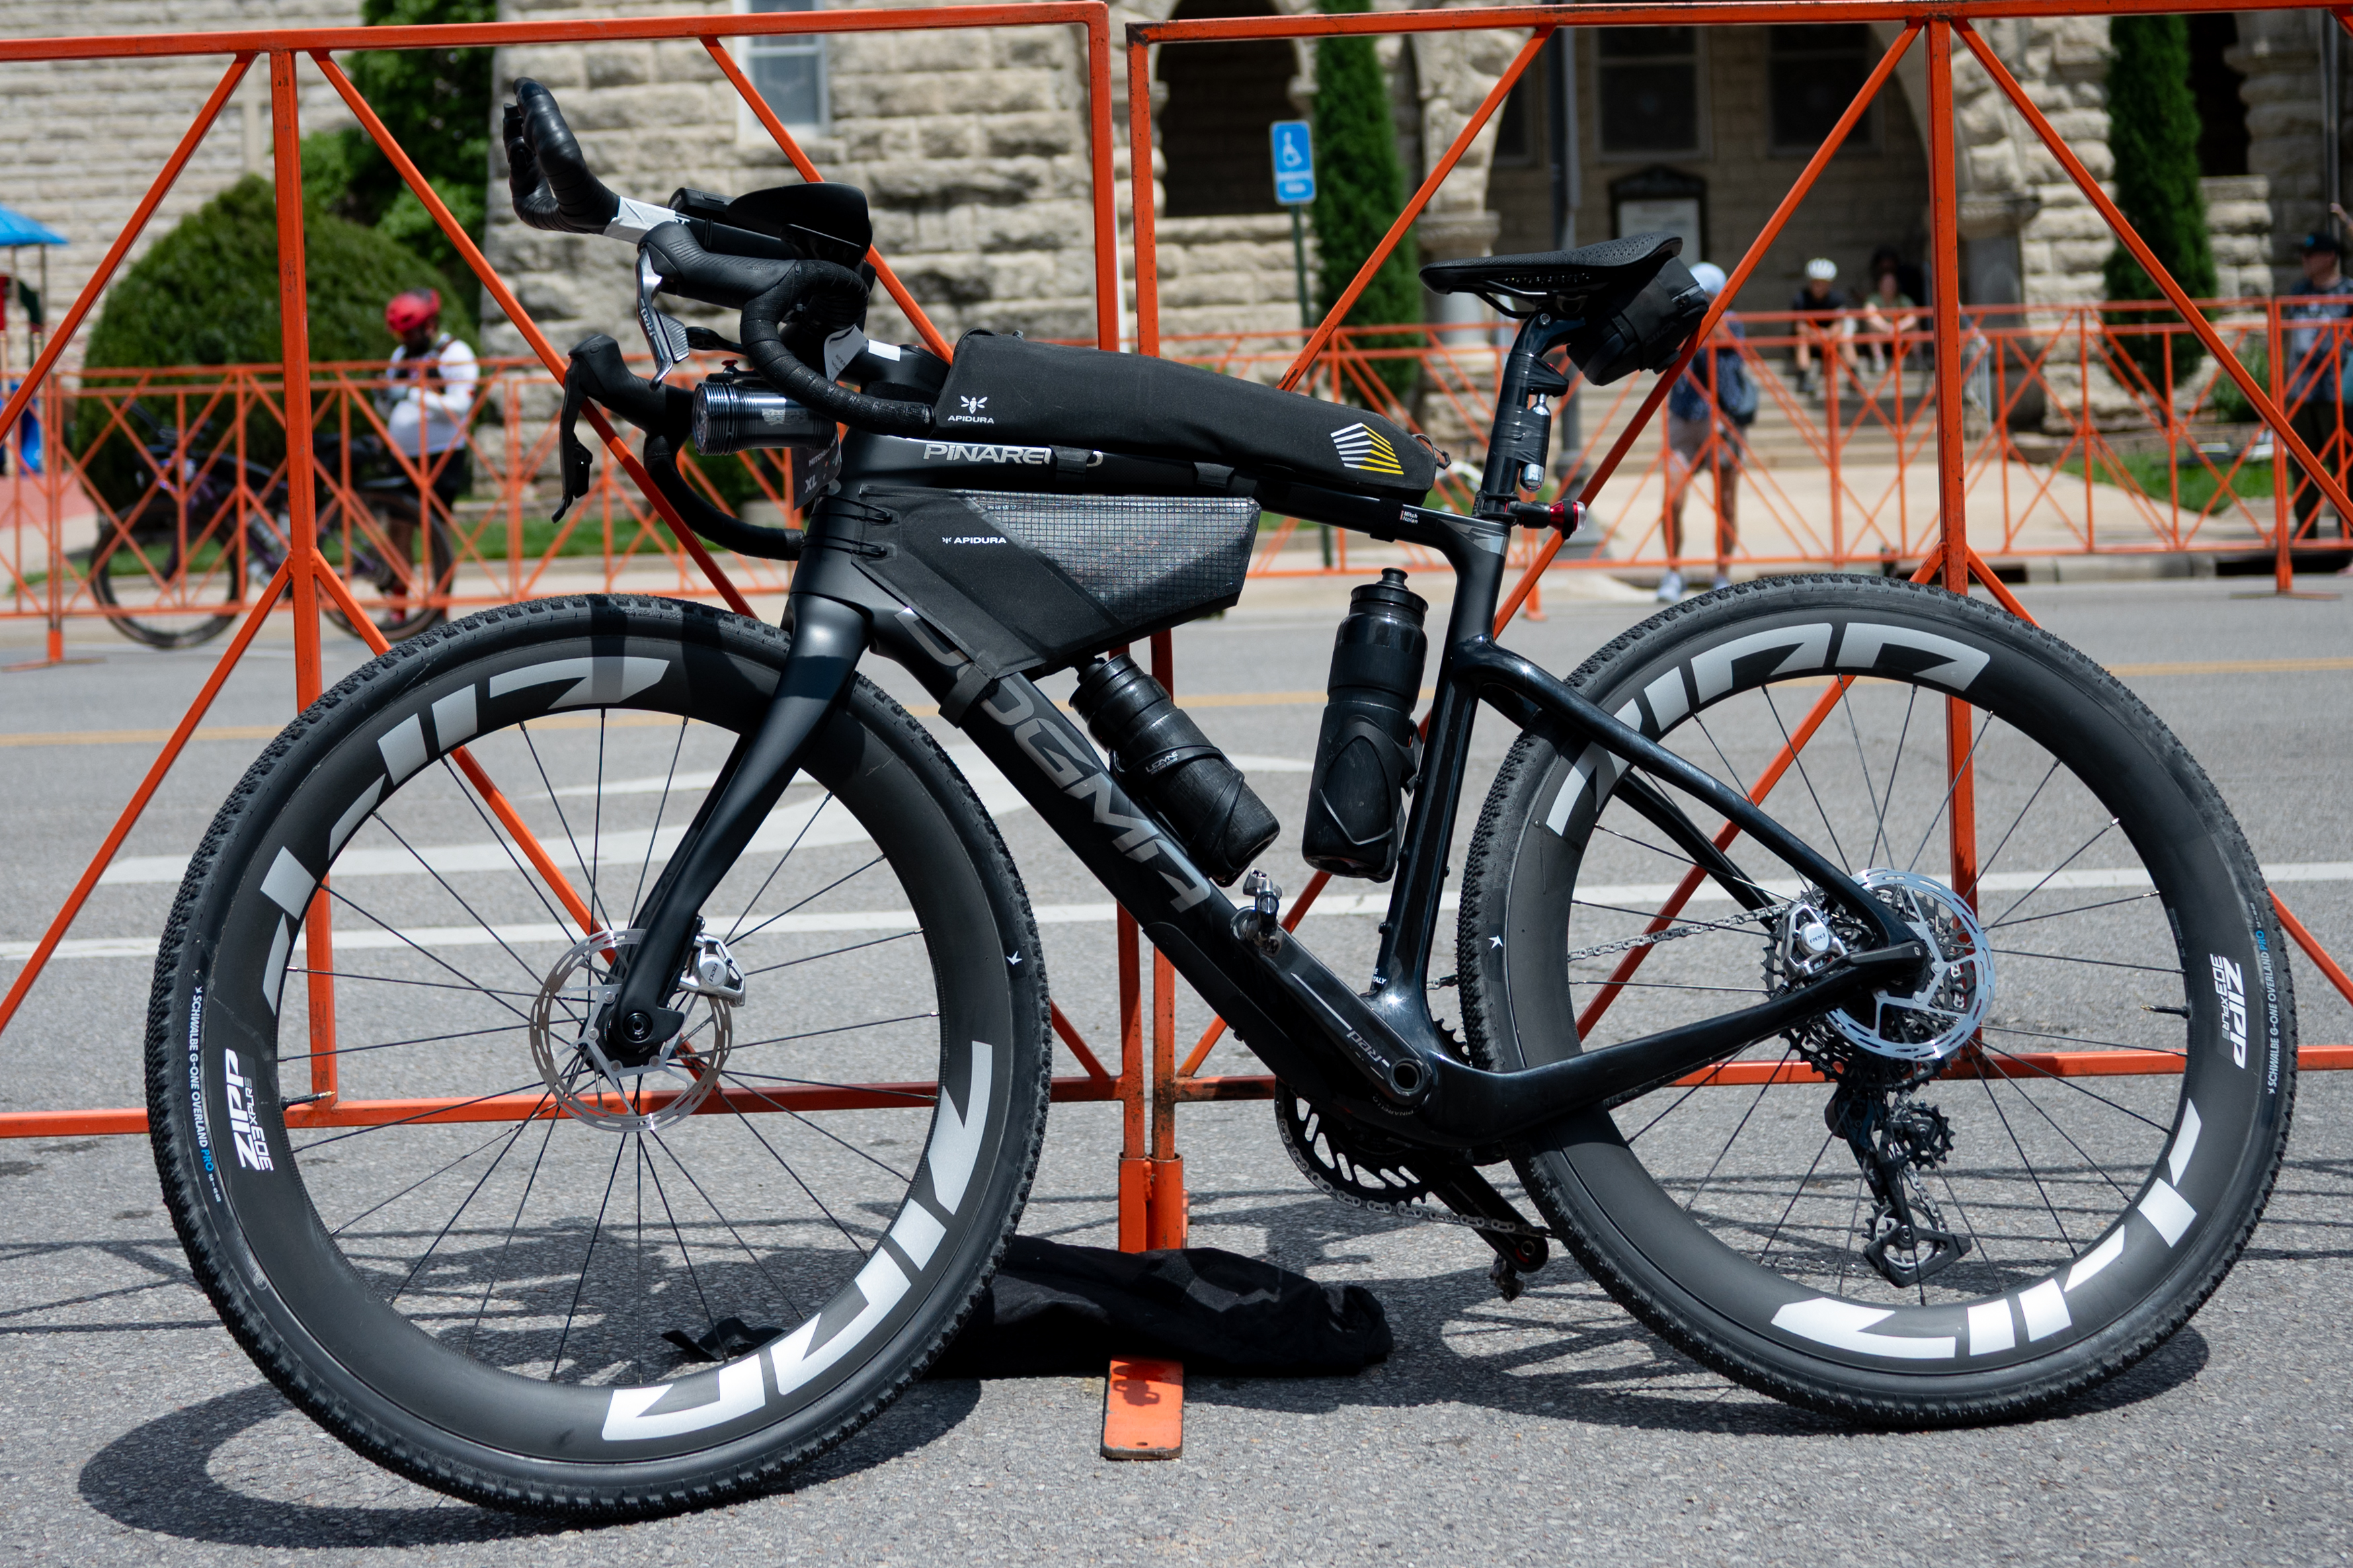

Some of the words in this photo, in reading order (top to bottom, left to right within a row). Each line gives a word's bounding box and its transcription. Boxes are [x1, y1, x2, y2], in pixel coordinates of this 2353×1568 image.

[947, 415, 994, 424] APIDURA
[804, 474, 817, 494] XL
[1402, 515, 1419, 524] Nolan
[1404, 511, 1418, 519] Mitch
[1145, 751, 1179, 773] LEZYNE
[2256, 930, 2268, 951] PRO
[1372, 975, 1387, 985] TALY
[2260, 951, 2277, 1002] OVERLAND
[189, 995, 202, 1051] SCHWALBE
[2223, 956, 2247, 1069] ZIPP
[2269, 1003, 2280, 1036] G-ONE
[189, 1051, 200, 1091] G-ONE
[2268, 1037, 2280, 1087] SCHWALBE
[190, 1090, 209, 1148] OVERLAND
[225, 1048, 261, 1171] ZIPP
[1372, 1096, 1414, 1116] PINARELLO
[201, 1148, 214, 1172] PRO
[250, 1126, 274, 1171] 303
